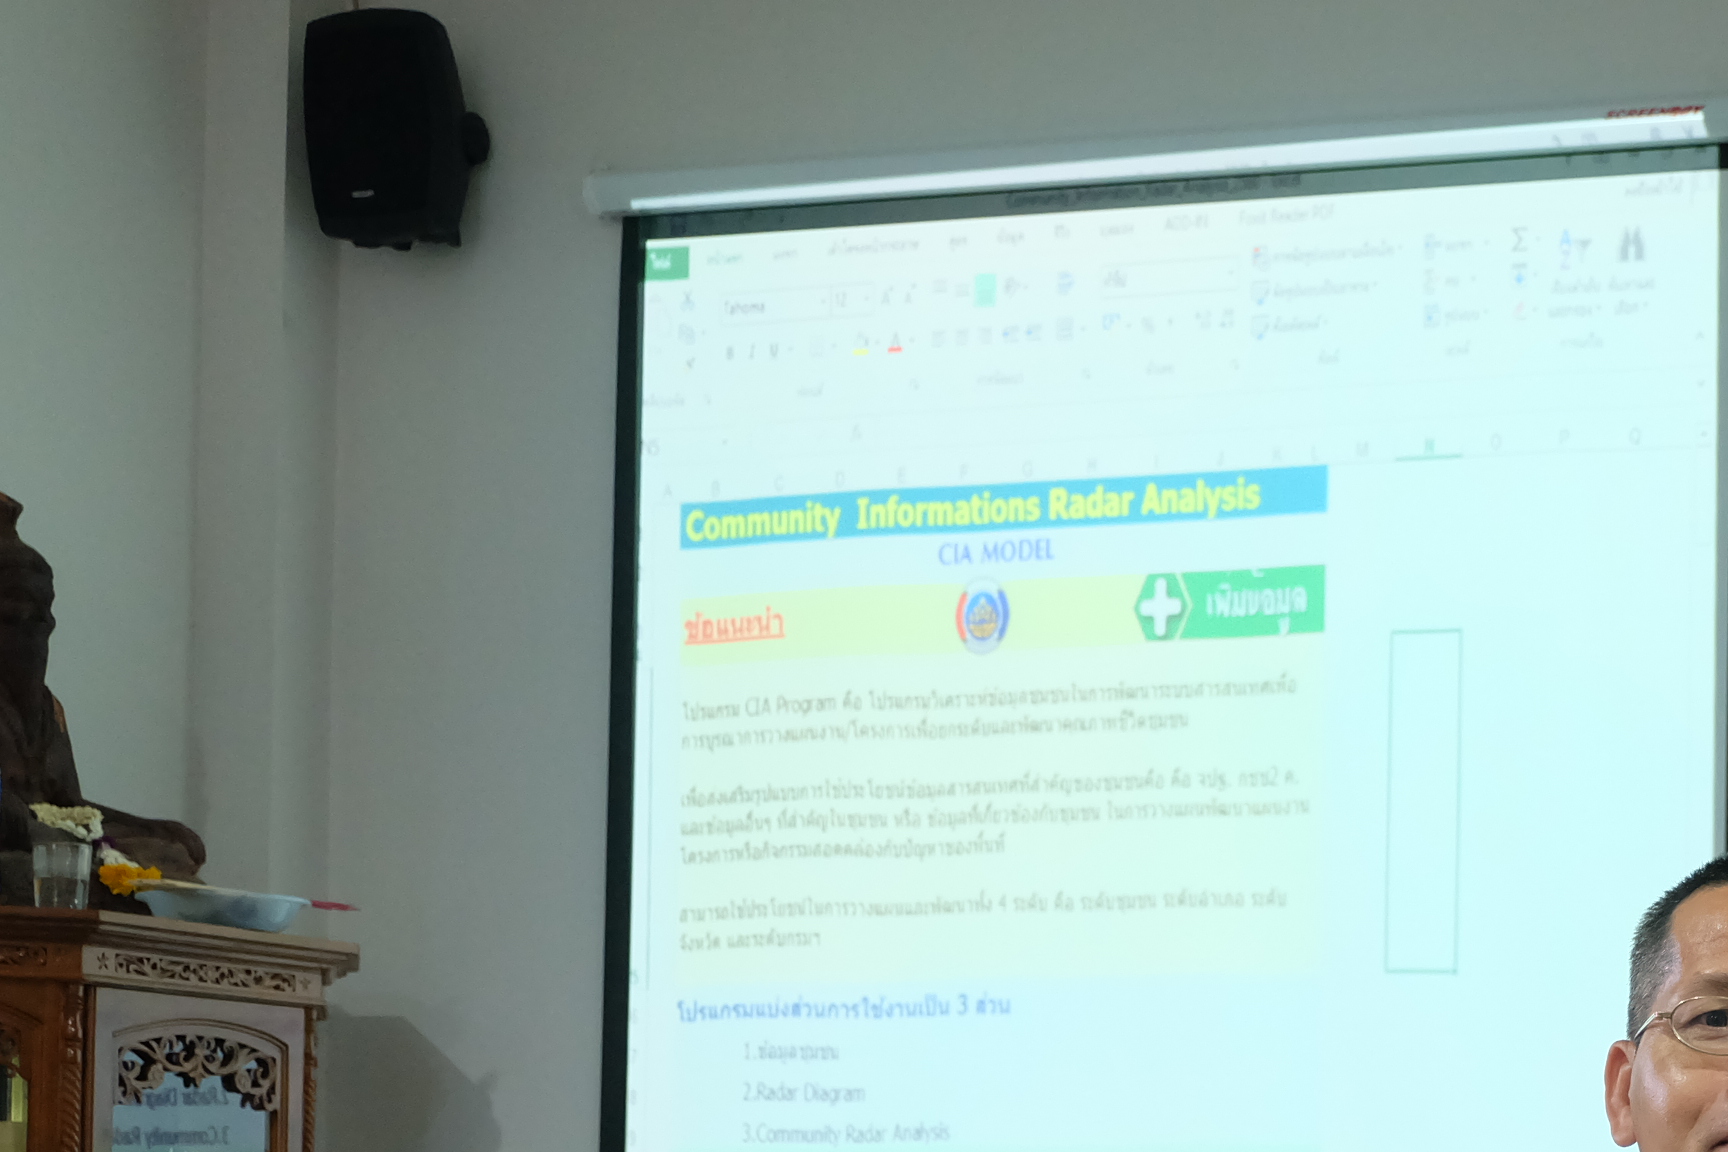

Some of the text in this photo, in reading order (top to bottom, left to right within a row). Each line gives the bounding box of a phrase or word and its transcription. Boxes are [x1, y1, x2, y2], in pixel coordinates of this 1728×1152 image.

[685, 476, 1261, 543] Community Informations Radar Analysis
[938, 538, 1055, 566] CIA MODEL
[745, 696, 773, 717] CIA
[776, 694, 837, 718] Program
[843, 688, 863, 712] คือ
[998, 893, 1007, 912] 4
[1054, 889, 1074, 912] คือ
[956, 993, 969, 1016] 3
[976, 990, 1012, 1016] ส่วน
[743, 1081, 866, 1107] 2.Radar Diagram
[742, 1121, 951, 1147] 3.Community Radar Analysis
